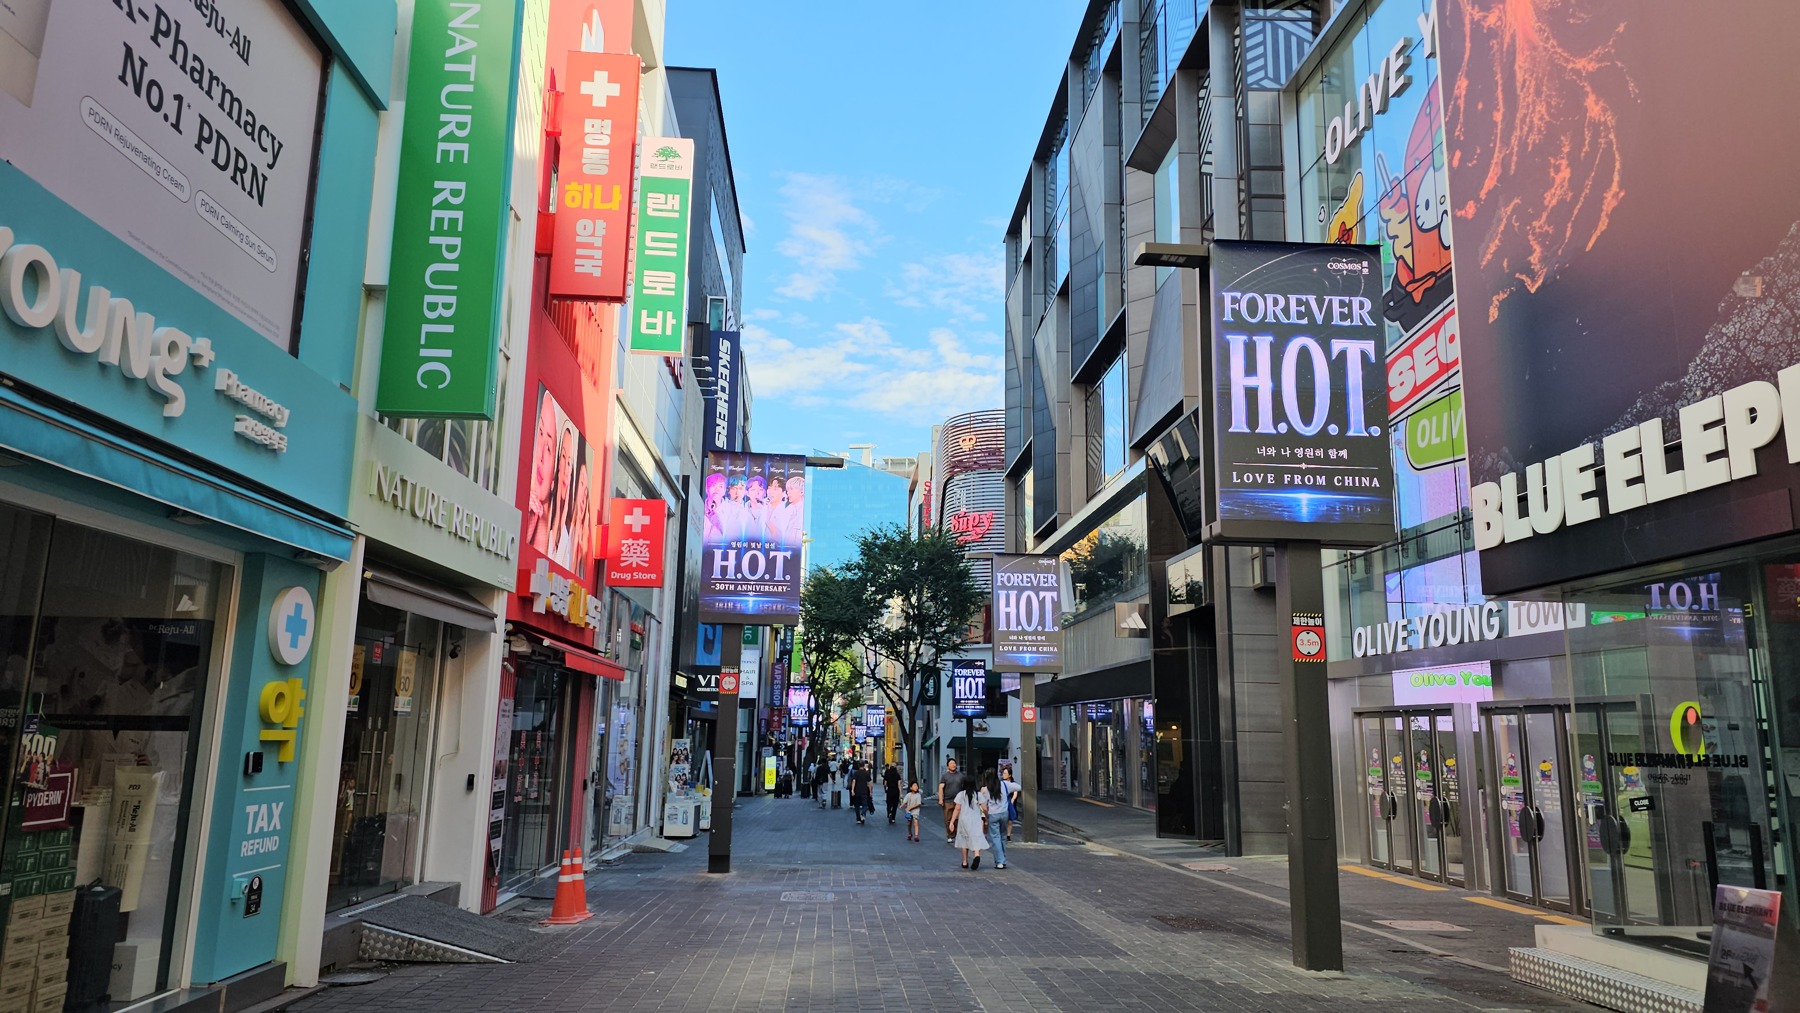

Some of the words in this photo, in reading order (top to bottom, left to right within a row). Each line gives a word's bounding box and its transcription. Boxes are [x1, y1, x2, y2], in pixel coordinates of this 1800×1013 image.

[188, 0, 251, 66] eju-All
[436, 0, 481, 164] NATURE
[1325, 36, 1412, 164] OLIVE
[88, 106, 113, 136] PDRN
[113, 128, 162, 180] Rejuvenating
[162, 168, 186, 194] Cream
[194, 113, 268, 207] PDRN
[582, 118, 612, 176] 명동
[564, 181, 622, 211] 하나
[200, 198, 221, 223] PDRN
[220, 216, 245, 247] Calming
[244, 235, 257, 253] Sun
[256, 244, 275, 266] Serum
[574, 218, 606, 277] 약국
[640, 192, 680, 336] 랜드로바
[1327, 262, 1361, 271] COSMOS
[416, 181, 466, 390] REPUBLIC
[1222, 292, 1377, 327] FOREVER
[214, 368, 290, 427] Pharmacy
[715, 338, 731, 450] SKECHERS
[1226, 335, 1381, 437] H.O.T.
[1257, 447, 1276, 457] 너와
[1281, 447, 1291, 458] 나
[1294, 447, 1324, 459] 영원히
[1328, 448, 1348, 460] 함께
[1233, 471, 1275, 484] LOVE
[1284, 474, 1326, 486] FROM
[1334, 475, 1381, 488] CHINA
[369, 462, 447, 529] NATURE
[448, 502, 515, 561] REPUBLIC
[619, 538, 650, 568] 藥
[711, 549, 791, 581] H.O.T.
[611, 571, 631, 582] Drug
[633, 572, 656, 580] Store
[996, 573, 1058, 587] FOREVER
[998, 590, 1058, 632] H.O.T.
[1353, 619, 1409, 658] OLIVE
[1415, 601, 1503, 649] YOUNG
[1512, 602, 1578, 630] TOWN
[158, 625, 194, 636] Reju-All
[1299, 639, 1319, 648] 3.5m
[773, 664, 782, 706] VAPESHOP
[954, 668, 985, 676] FOREVER
[954, 677, 985, 699] H.O.T.
[1410, 671, 1456, 687] Olive
[260, 677, 306, 763] 약
[1607, 752, 1633, 767] BLUE
[246, 802, 284, 835] TAX
[240, 835, 279, 857] REFUND
[1719, 902, 1736, 913] BLUE
[1737, 904, 1774, 918] ELEPHANT
